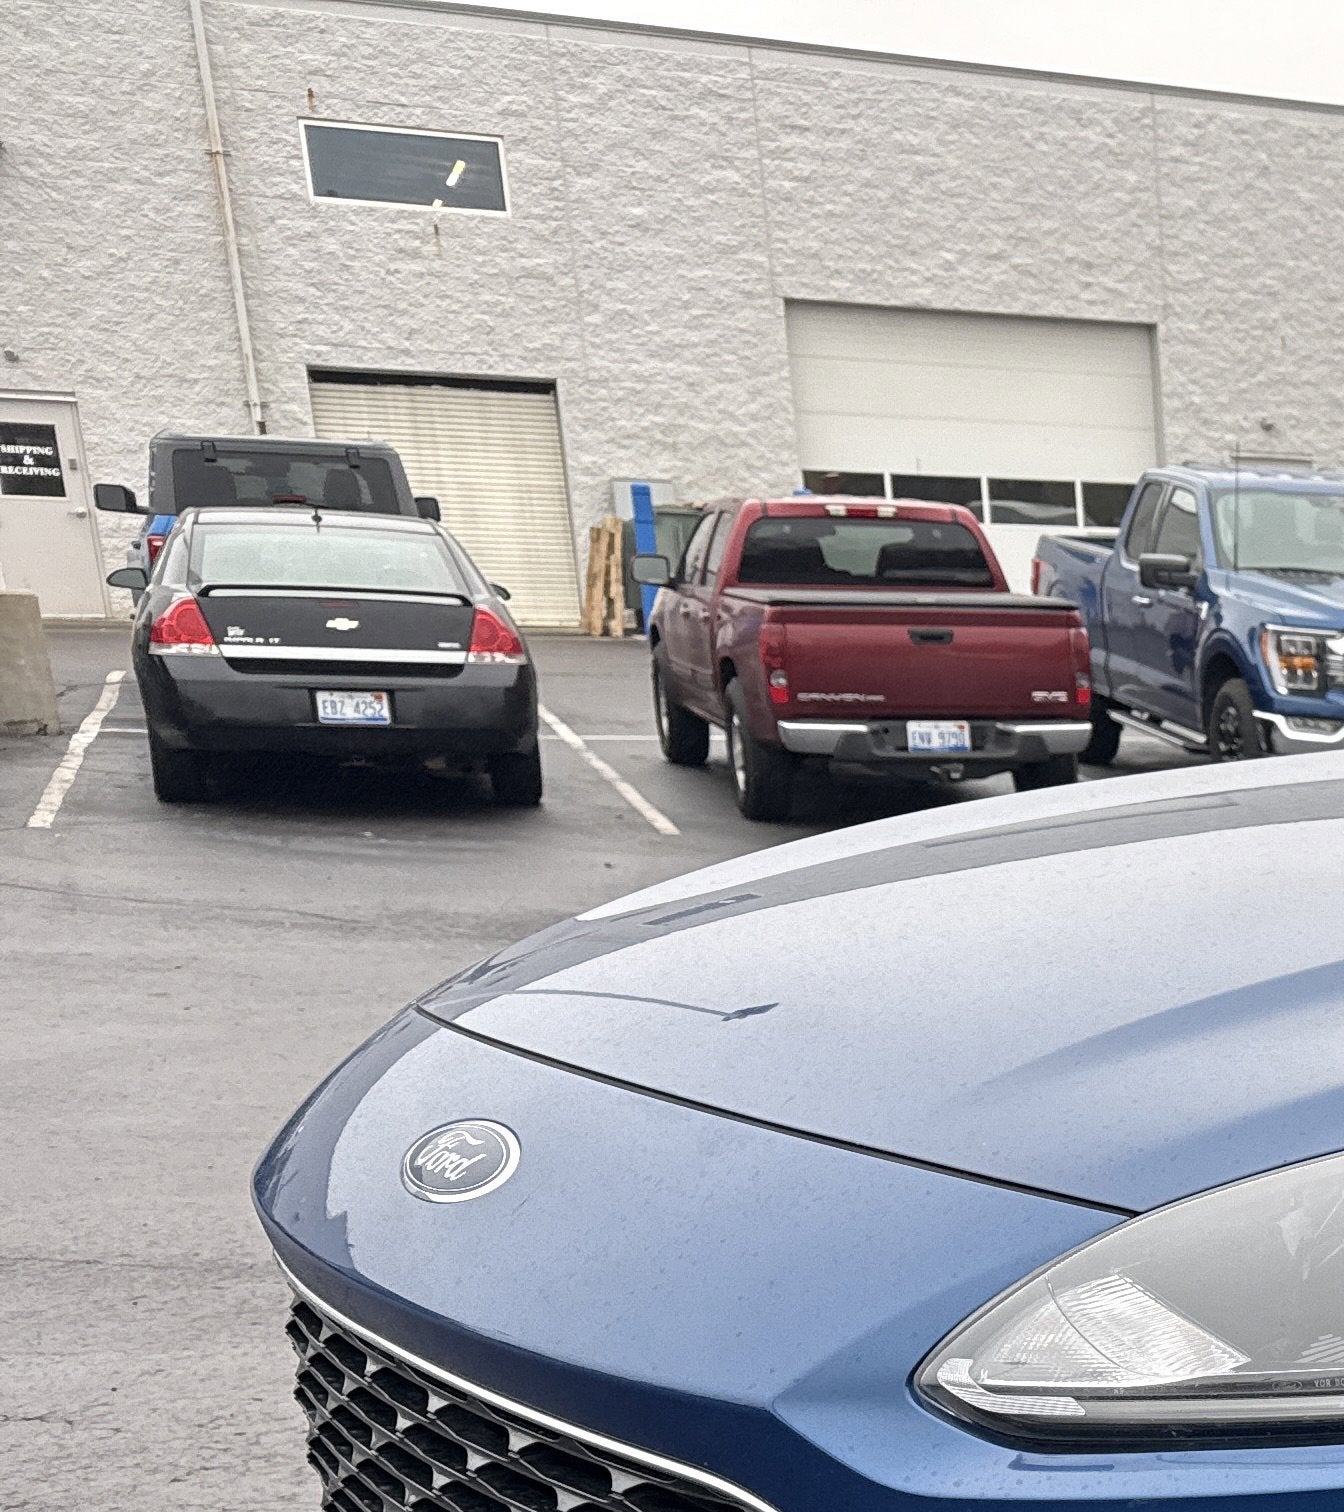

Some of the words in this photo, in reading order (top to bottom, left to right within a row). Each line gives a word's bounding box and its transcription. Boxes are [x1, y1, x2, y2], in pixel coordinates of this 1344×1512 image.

[0, 444, 54, 456] SHIPPING
[23, 455, 35, 465] &
[0, 465, 61, 477] RECEIVING
[353, 699, 384, 718] 4252
[414, 1130, 488, 1182] Ford
